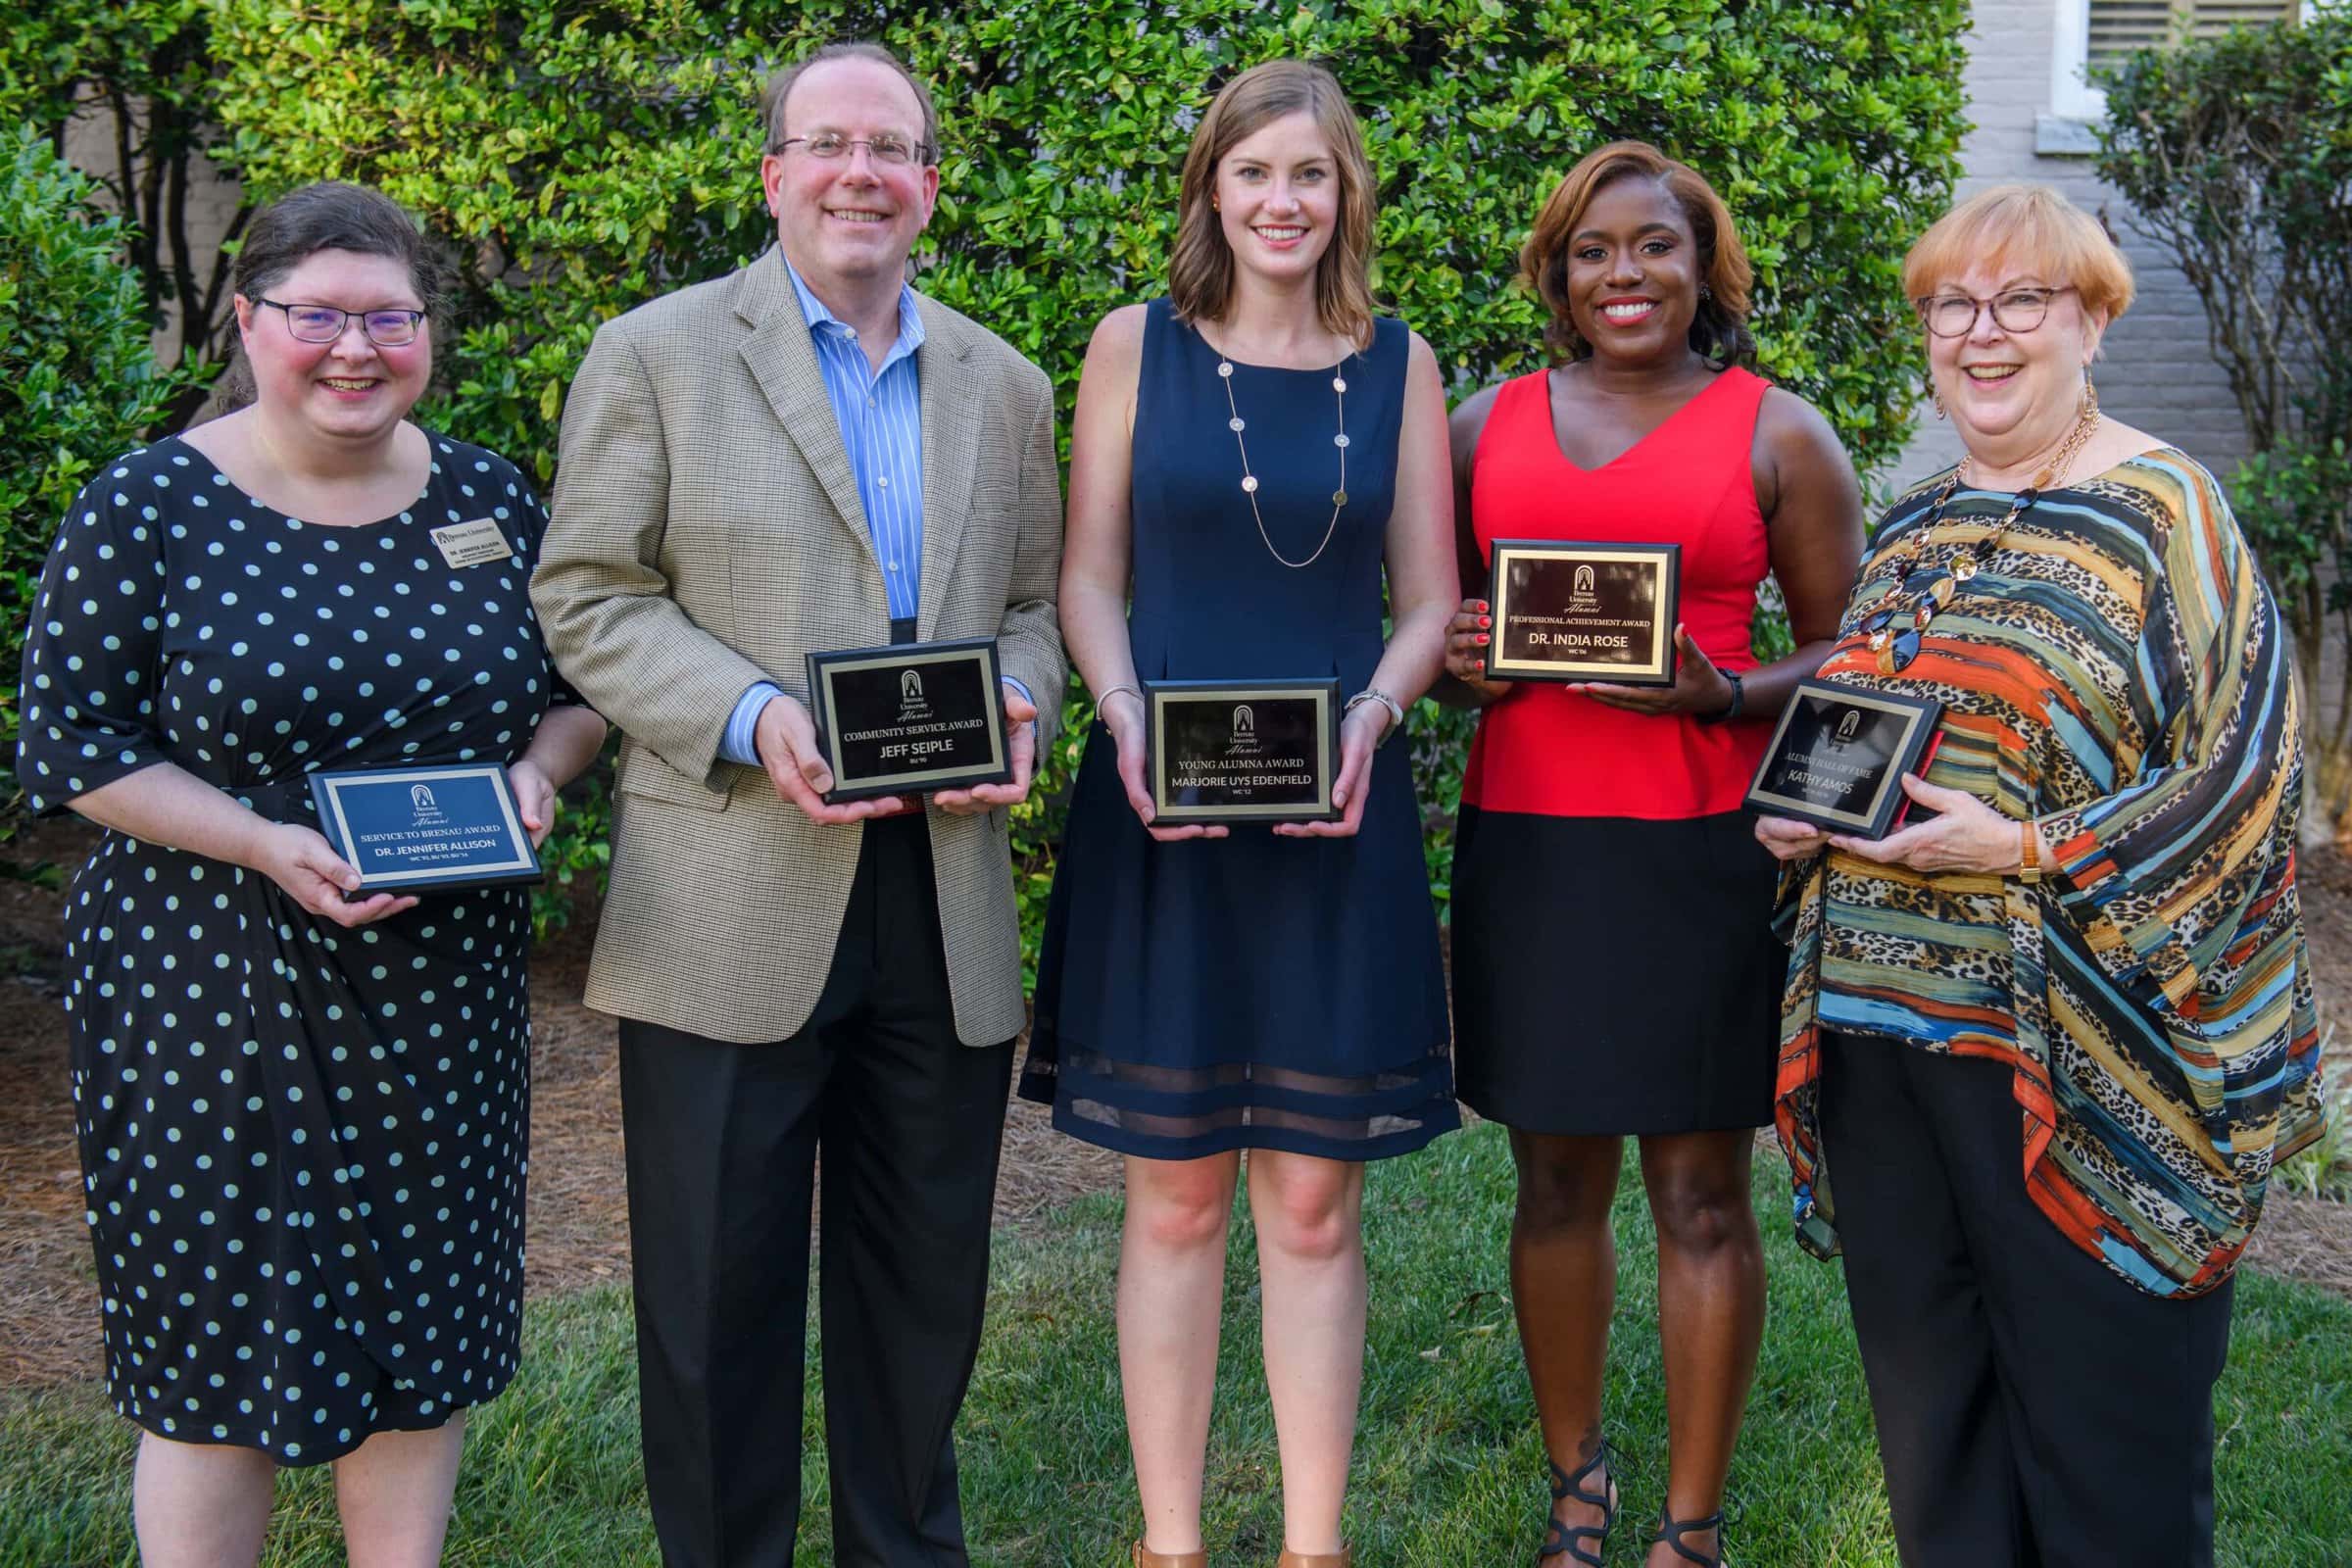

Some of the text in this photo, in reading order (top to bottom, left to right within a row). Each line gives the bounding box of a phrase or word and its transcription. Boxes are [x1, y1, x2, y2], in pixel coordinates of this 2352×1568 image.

[1563, 604, 1602, 613] Alumni
[1509, 615, 1565, 625] PROFESSIONAL
[1567, 616, 1620, 626] ACHIEVEMENT
[1529, 633, 1629, 647] DR. INDIA ROSE
[897, 710, 934, 722] Alumni
[844, 718, 983, 742] COMMUNITY SERVICE AWARD
[880, 739, 955, 759] JEFF SEIPLE
[1225, 745, 1263, 756] Alumni
[1179, 758, 1304, 770] YOUNG ALUMNA AWARD
[1171, 774, 1311, 788] MARJORIE UYS EDENFIELD
[1788, 769, 1823, 785] KATHY
[1820, 777, 1854, 794] AMOS
[412, 815, 449, 827] Alumni
[361, 824, 501, 843] SERVICE TO BRENAU AWARD
[375, 839, 497, 857] DR. JENNIFER ALLISON
